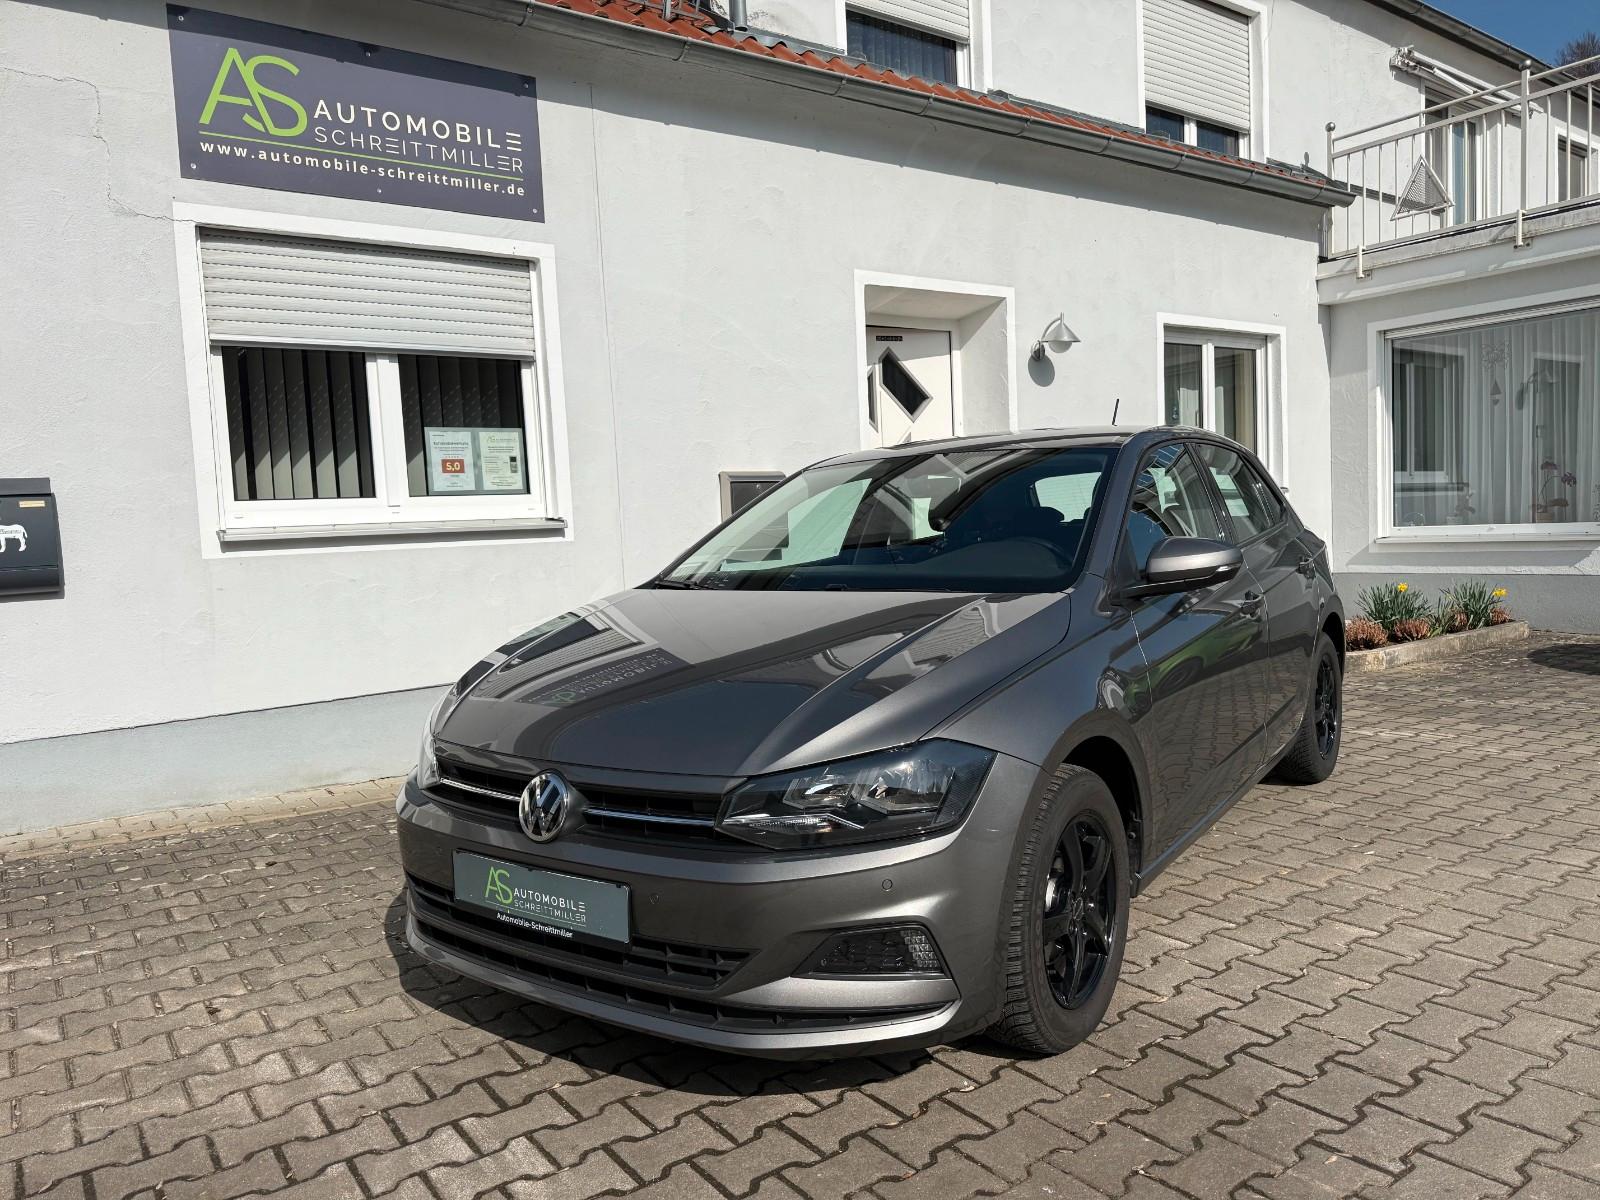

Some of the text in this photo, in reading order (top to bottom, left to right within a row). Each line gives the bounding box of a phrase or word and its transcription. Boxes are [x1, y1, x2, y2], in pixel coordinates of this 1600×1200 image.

[199, 47, 308, 137] AS
[313, 99, 522, 152] AUTOMOBILE
[200, 141, 526, 197] www.automobile-schreittmiller.de
[314, 126, 524, 174] SCHREITTMILLER
[484, 866, 513, 904] AS
[513, 887, 586, 912] AUTOMOBILE
[496, 912, 574, 939] Automobile-Schreittmiller
[513, 899, 587, 923] SCHREITTMILLER
